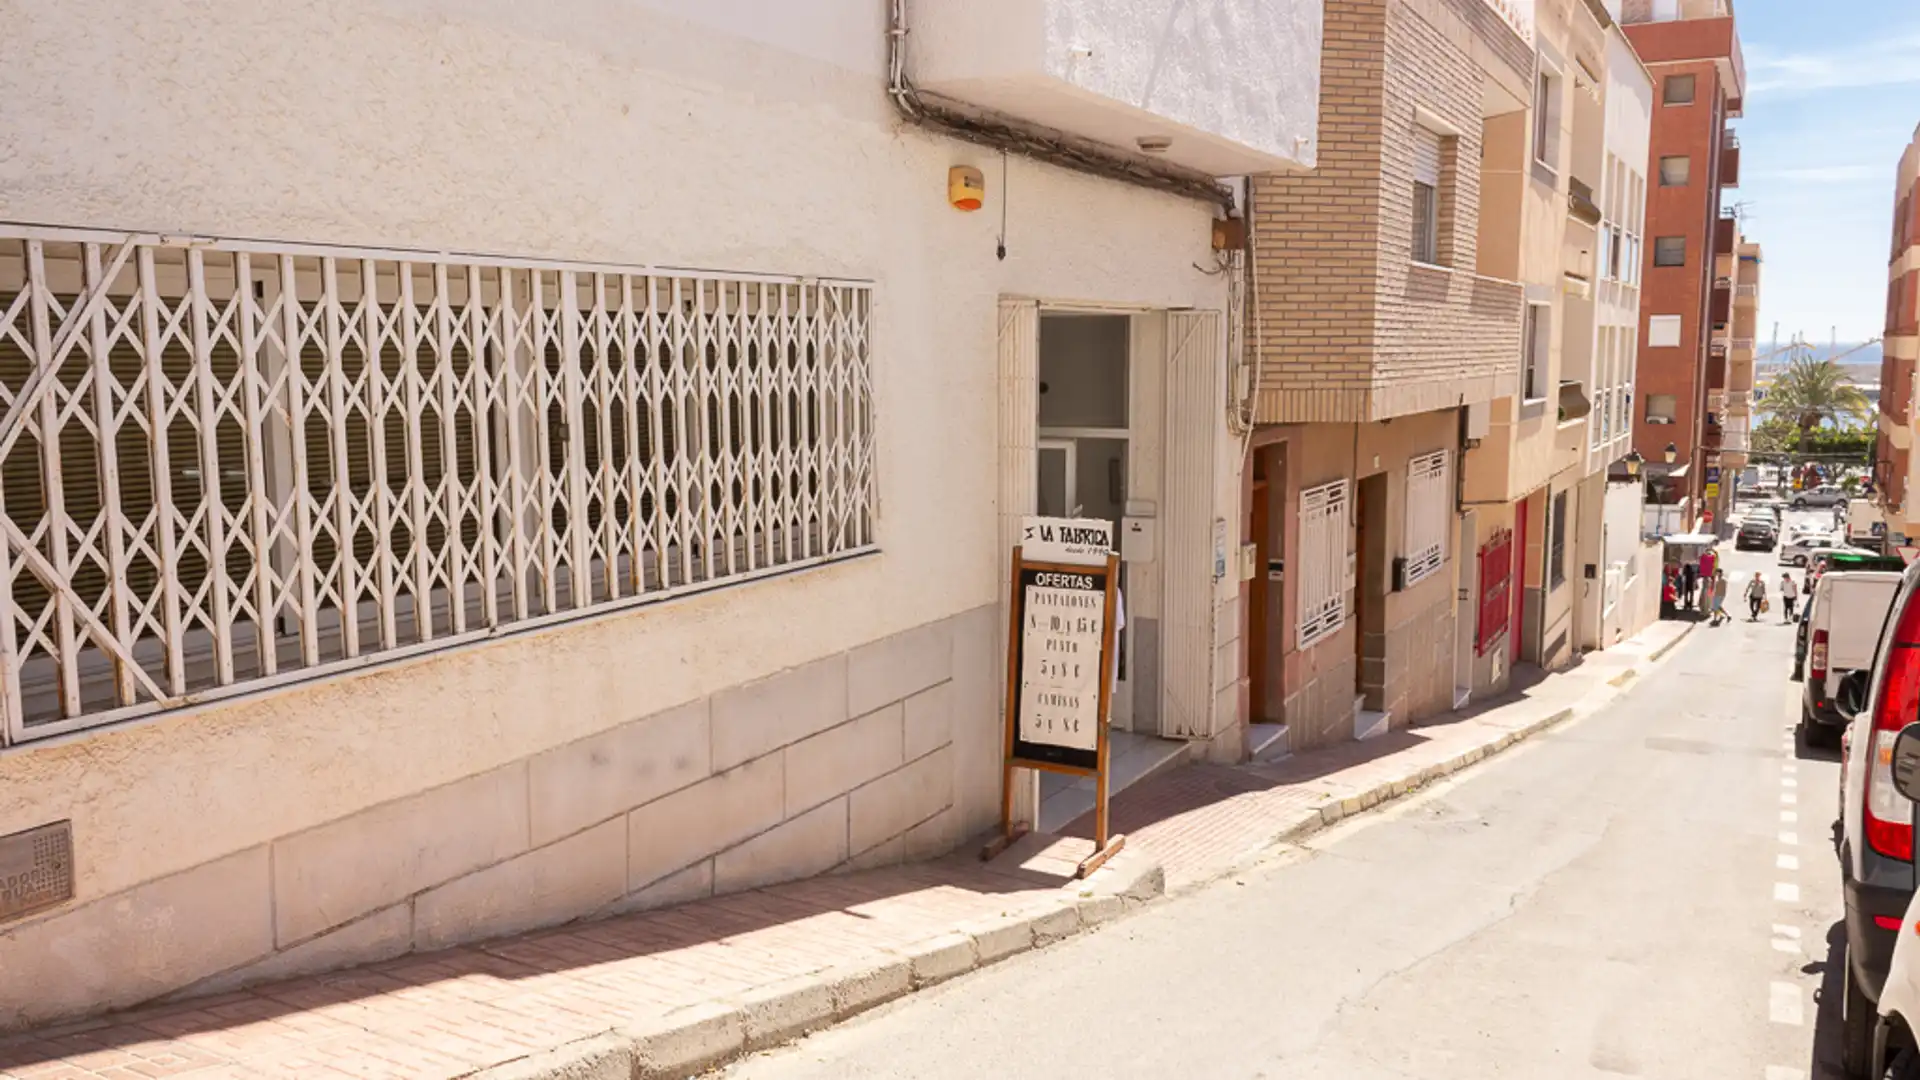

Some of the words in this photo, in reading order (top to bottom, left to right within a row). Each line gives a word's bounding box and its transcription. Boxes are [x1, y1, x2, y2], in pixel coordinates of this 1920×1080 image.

[1039, 524, 1054, 543] LA
[1035, 572, 1093, 589] OFERTAS
[1034, 592, 1096, 609] PANTALONES
[1037, 693, 1080, 709] CAMISAS
